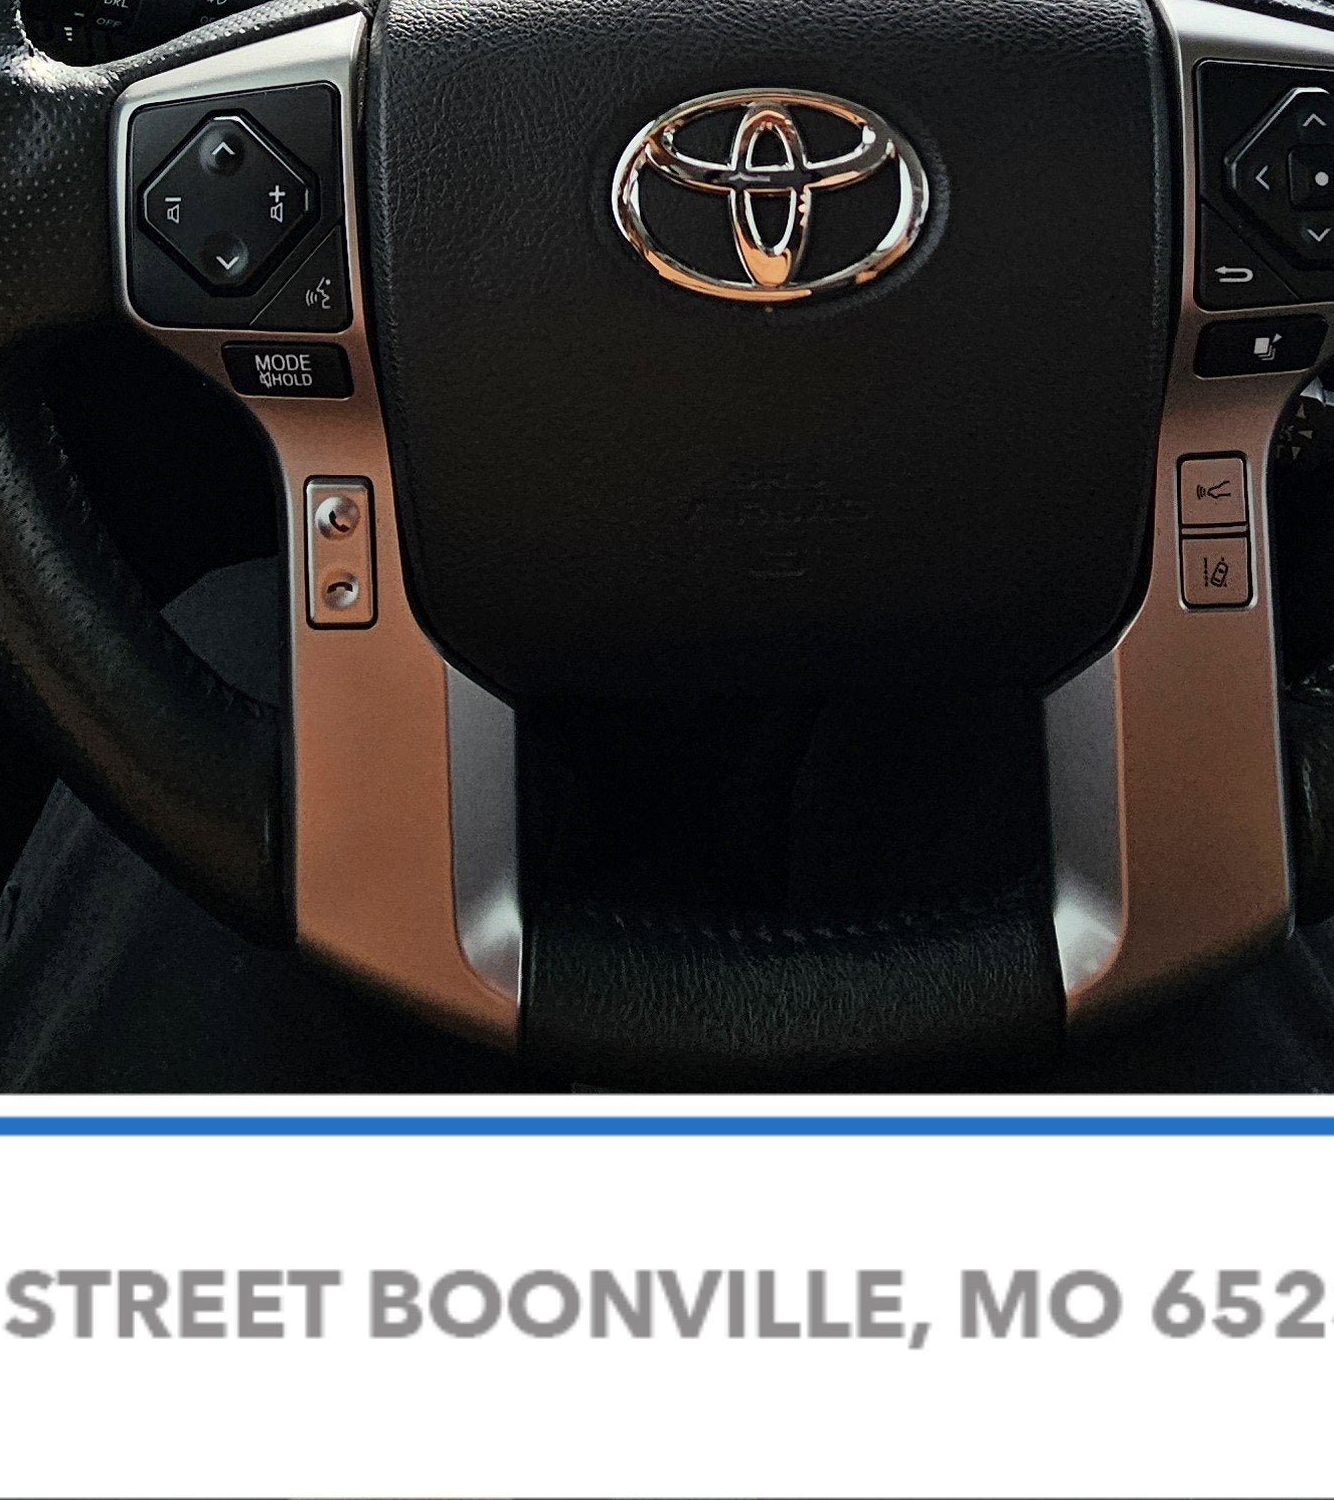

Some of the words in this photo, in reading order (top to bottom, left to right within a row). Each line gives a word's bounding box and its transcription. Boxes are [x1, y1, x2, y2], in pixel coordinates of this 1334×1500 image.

[95, 17, 123, 28] OFF
[255, 354, 312, 372] MODE
[272, 373, 313, 387] HOLD
